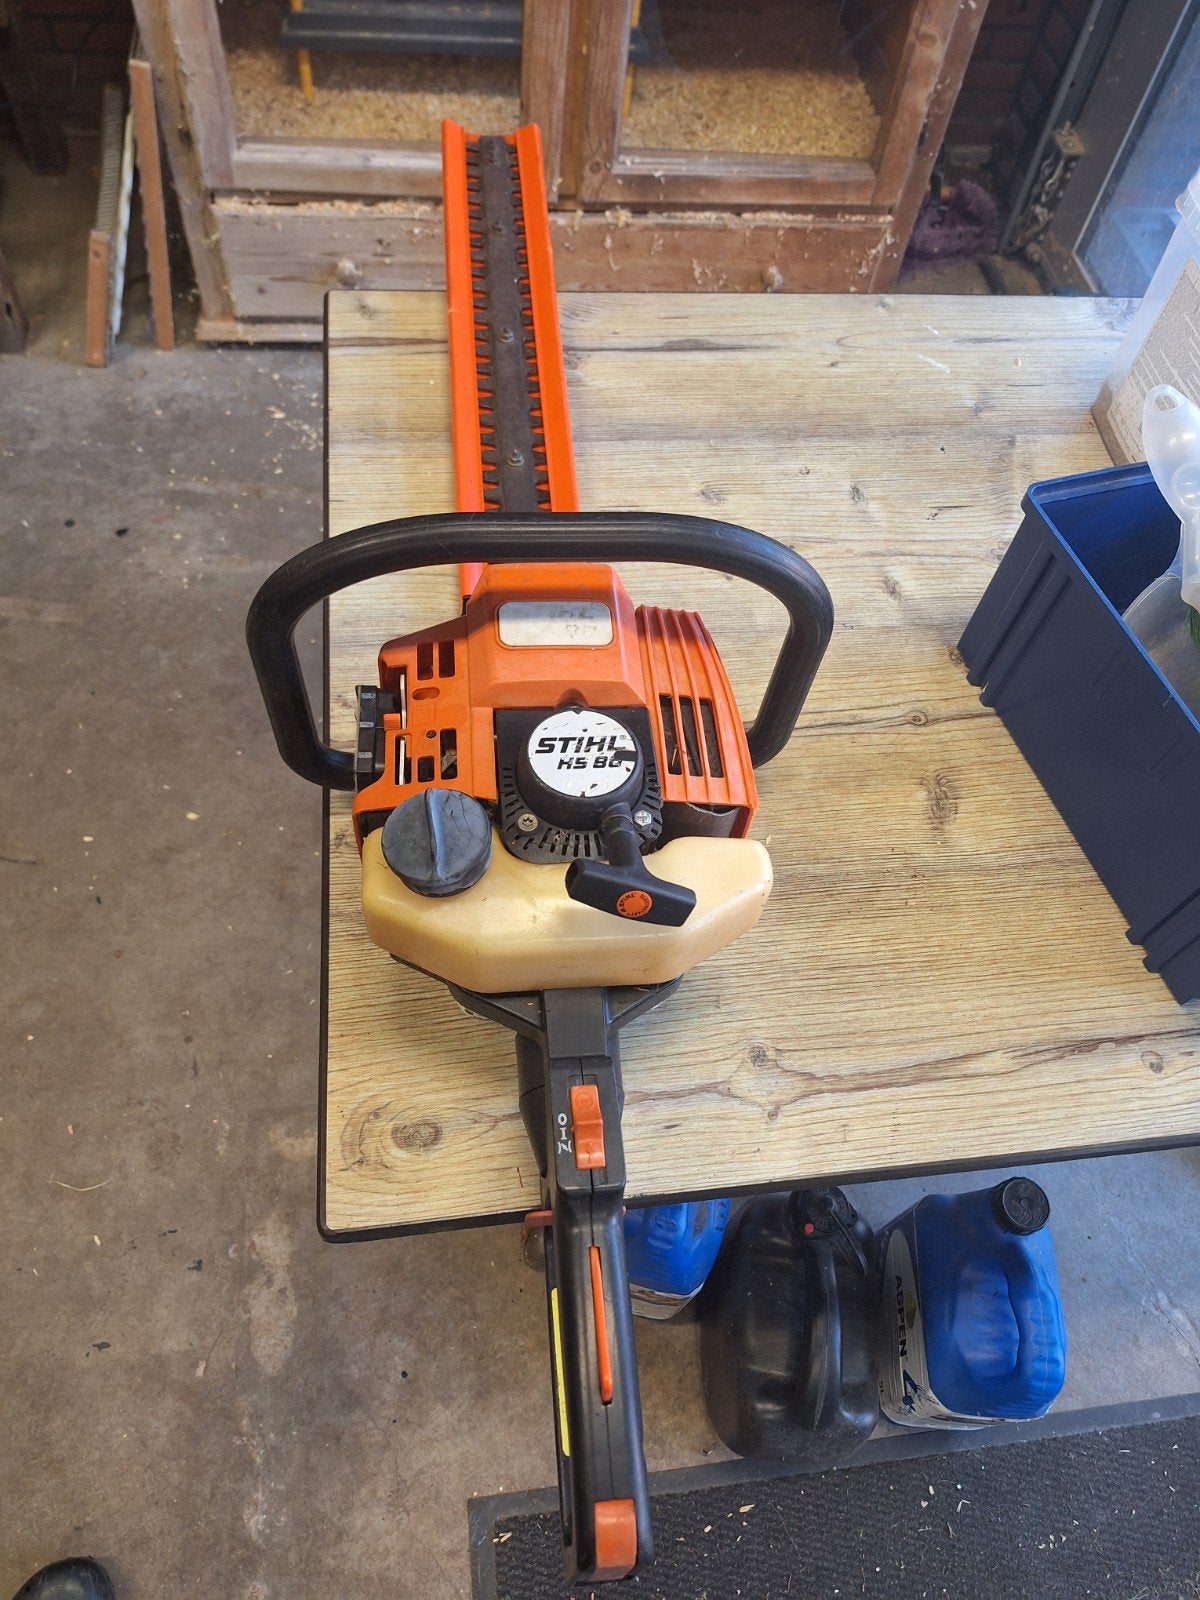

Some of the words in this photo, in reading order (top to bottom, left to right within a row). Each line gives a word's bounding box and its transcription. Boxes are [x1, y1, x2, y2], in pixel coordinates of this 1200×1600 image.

[535, 735, 626, 754] STIHL
[557, 757, 588, 770] HS
[896, 1275, 907, 1357] ASPEN
